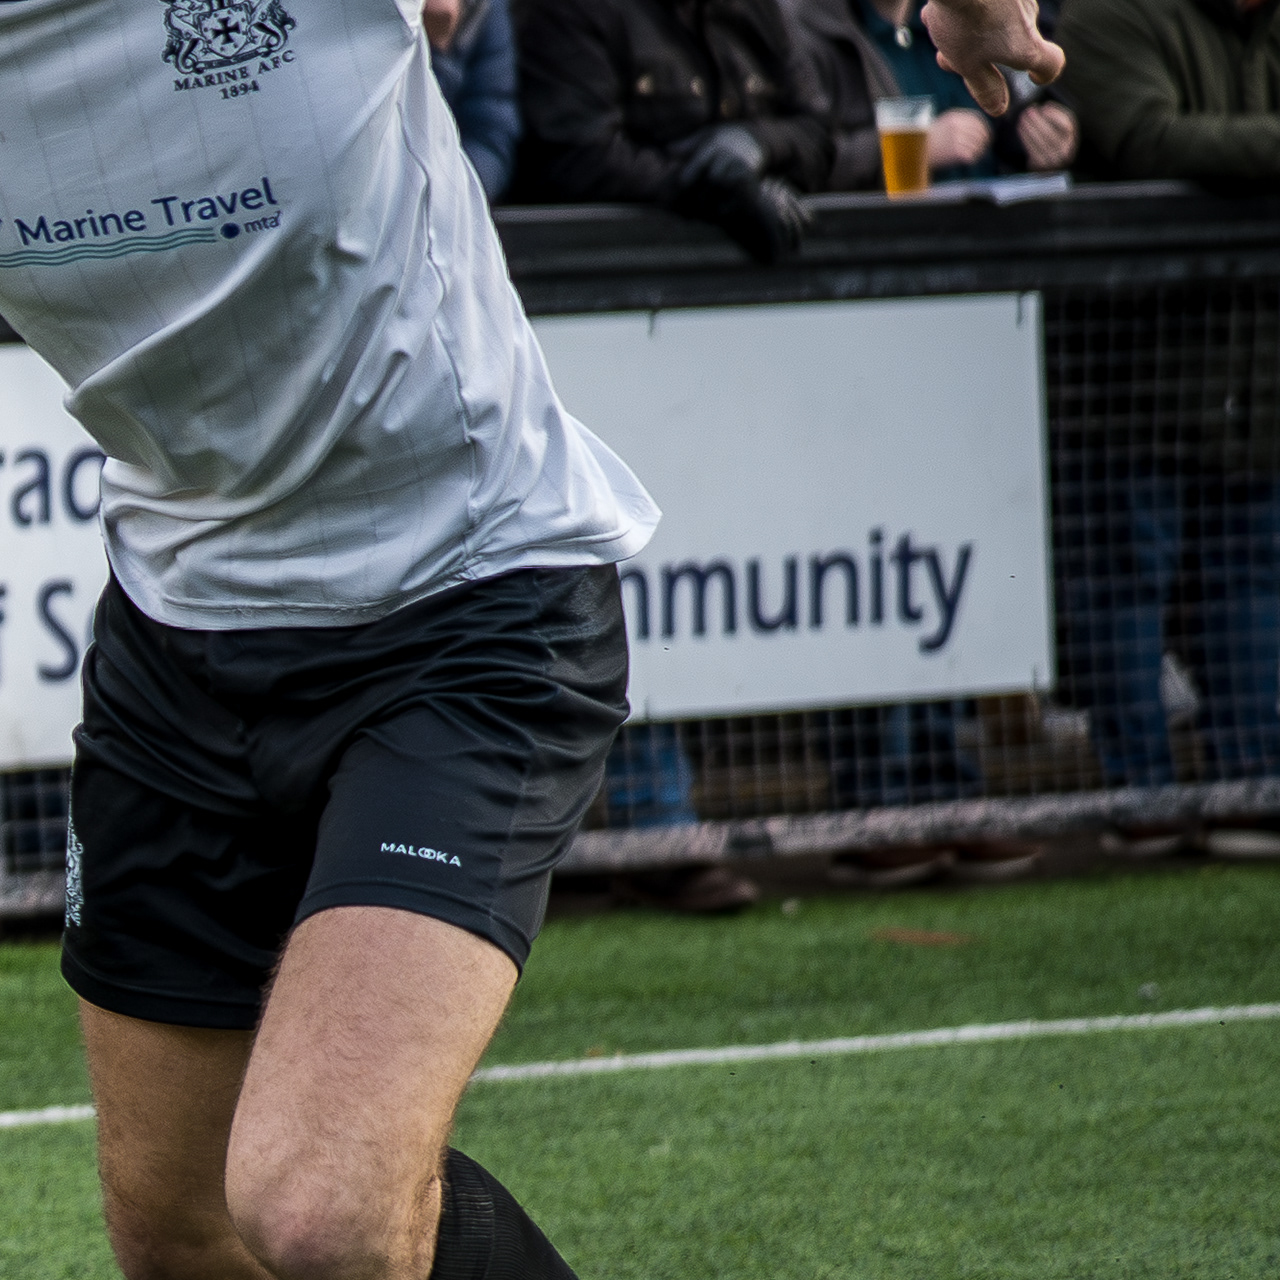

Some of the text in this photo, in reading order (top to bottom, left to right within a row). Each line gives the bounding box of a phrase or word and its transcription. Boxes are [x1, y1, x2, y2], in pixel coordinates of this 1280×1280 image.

[174, 66, 250, 91] MARINE
[258, 50, 294, 74] AFC
[220, 80, 259, 99] 1894
[14, 177, 277, 246] Marine Travel
